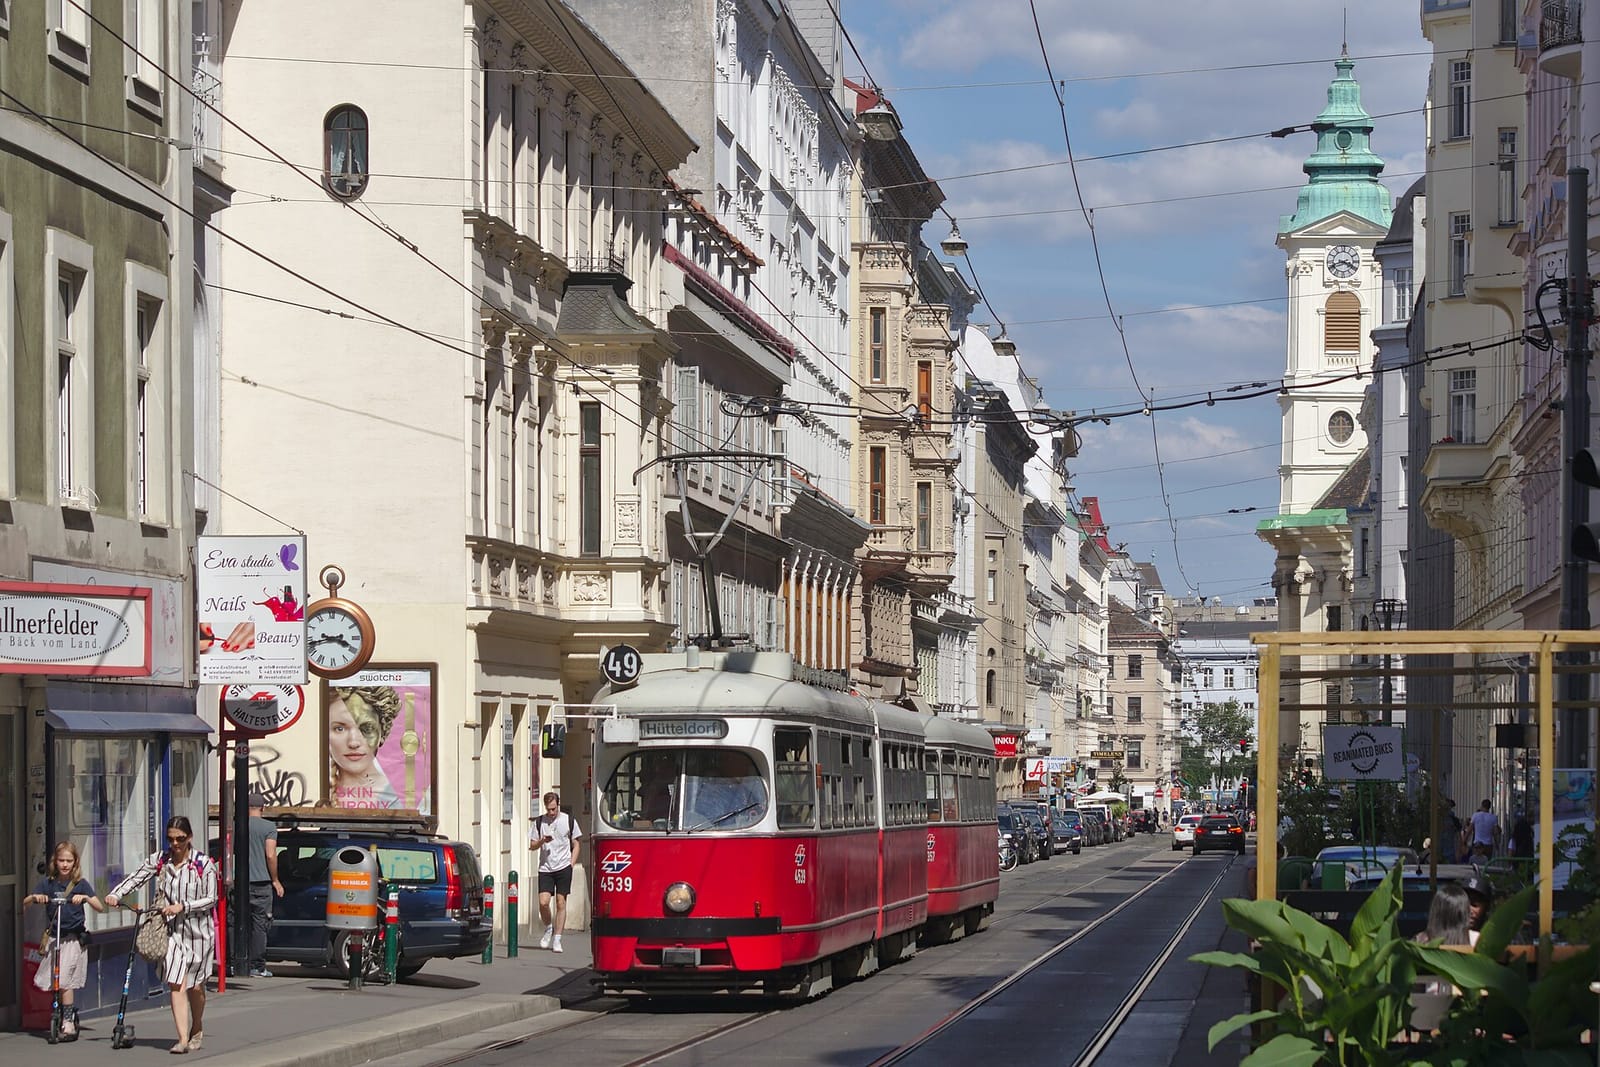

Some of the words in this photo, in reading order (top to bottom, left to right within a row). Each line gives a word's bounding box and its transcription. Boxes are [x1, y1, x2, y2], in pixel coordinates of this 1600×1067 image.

[204, 549, 238, 570] Eva
[240, 554, 276, 568] studio
[204, 595, 246, 613] Nails
[0, 606, 99, 636] llnerfelder
[42, 638, 64, 648] vom
[70, 637, 102, 649] Land.
[256, 631, 301, 648] Beauty
[607, 651, 637, 677] 49
[359, 673, 395, 682] swatch
[233, 706, 293, 726] HALTESTELLE
[646, 721, 717, 736] Hütteldorf
[994, 736, 1015, 745] INKU
[236, 745, 249, 756] 49
[1333, 746, 1374, 763] REANIMATED
[1374, 742, 1393, 755] BIKES
[335, 785, 373, 798] SKIN
[600, 876, 633, 893] 4539
